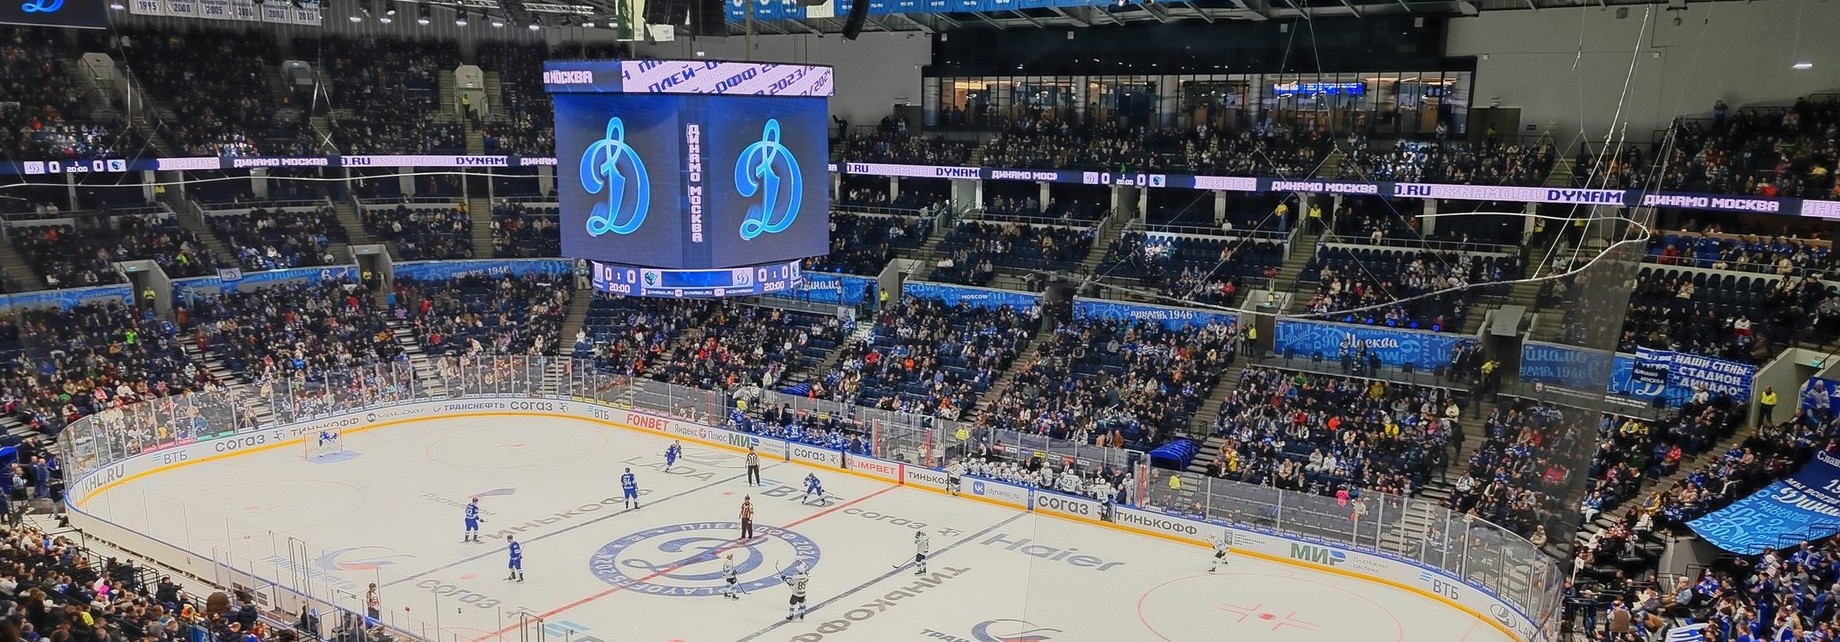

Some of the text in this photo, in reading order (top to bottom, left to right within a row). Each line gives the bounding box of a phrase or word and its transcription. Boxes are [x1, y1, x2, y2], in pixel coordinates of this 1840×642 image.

[551, 70, 593, 84] МОСКВА
[234, 158, 328, 168] ДИНАМО МОСКВА
[456, 156, 507, 166] DYNAM
[936, 167, 980, 178] DYNAM
[992, 170, 1031, 180] ДИНАМО
[687, 124, 703, 242] ДИНАМО МОСКВА
[1271, 181, 1378, 194] ДИНАМО МОСКВА
[1547, 190, 1623, 204] DYNAM
[1643, 194, 1779, 211] ДИНАМО МОСКВА
[609, 282, 631, 293] 20:00
[763, 281, 785, 291] 20:00
[1169, 310, 1193, 320] 1946
[1675, 355, 1710, 369] НАШИ
[1679, 365, 1741, 385] СТАДИОН
[377, 408, 425, 419] VALDAI
[444, 402, 505, 411] ТРАНСНЕФТЬ
[594, 410, 609, 420] ВТБ
[626, 413, 669, 431] FONBET
[675, 424, 727, 442] Яндекс Плюс
[728, 433, 760, 448] МИР
[164, 450, 188, 465] ВТБ
[620, 456, 716, 482] LADA
[84, 464, 125, 493] KHL.RU
[1064, 478, 1073, 487] 23
[980, 533, 1125, 572] Haier
[1291, 544, 1347, 567] МИР
[1433, 578, 1459, 600] ВТБ
